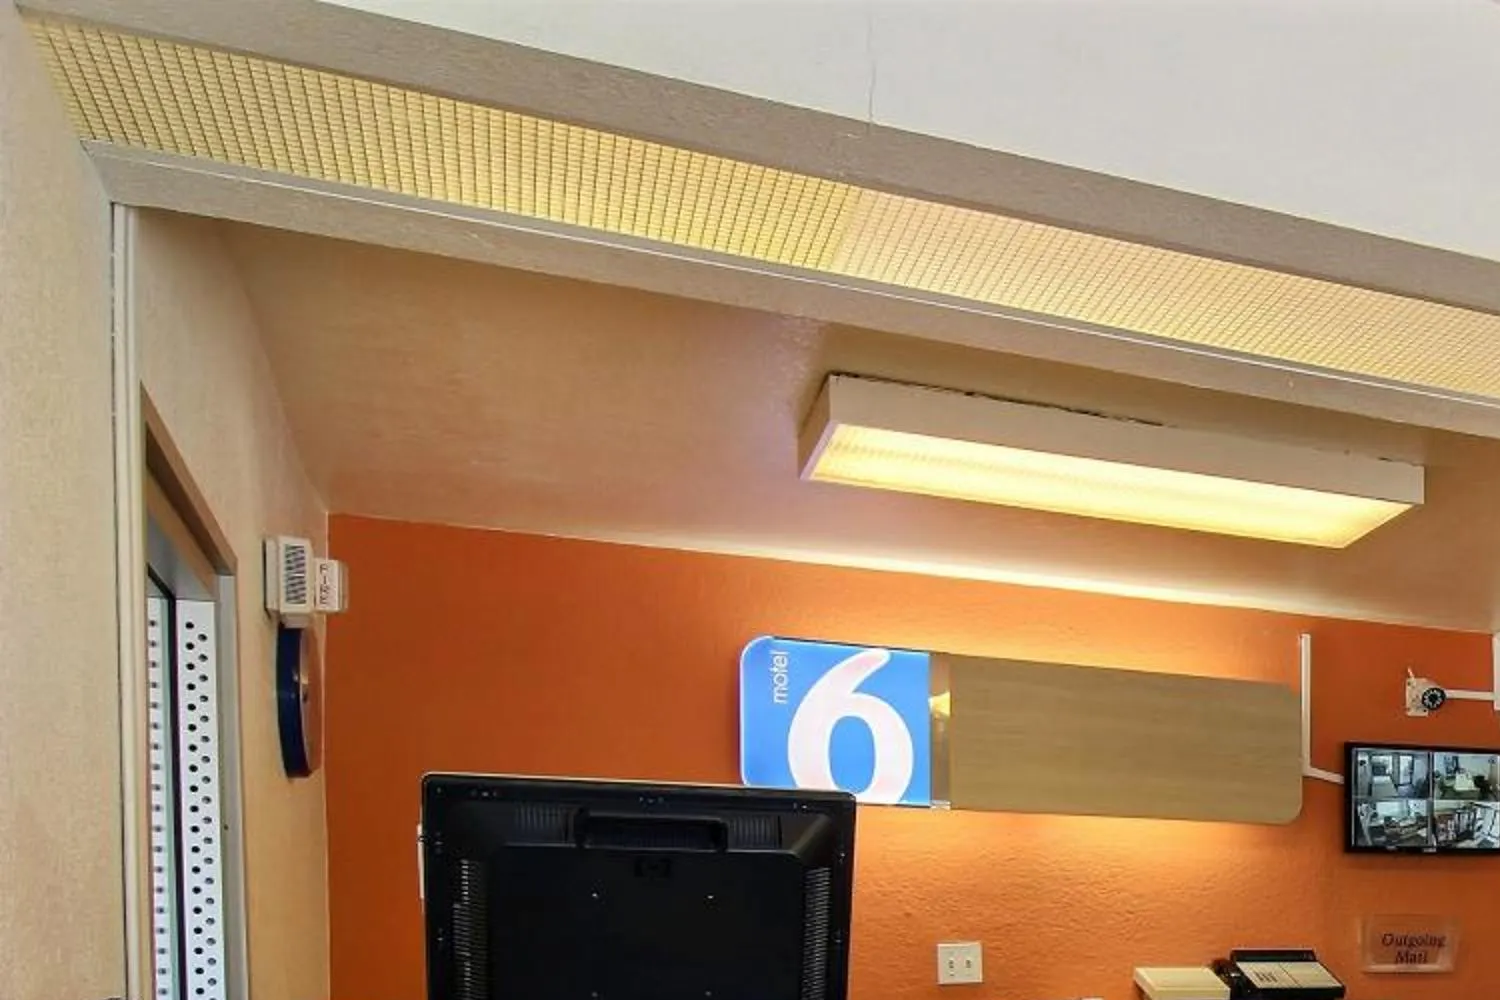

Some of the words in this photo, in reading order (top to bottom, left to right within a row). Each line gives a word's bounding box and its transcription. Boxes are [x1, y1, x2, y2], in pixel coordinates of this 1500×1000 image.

[769, 651, 788, 704] motel
[788, 649, 914, 804] 6
[1381, 932, 1447, 949] Outgoing
[1394, 949, 1429, 965] Mail
